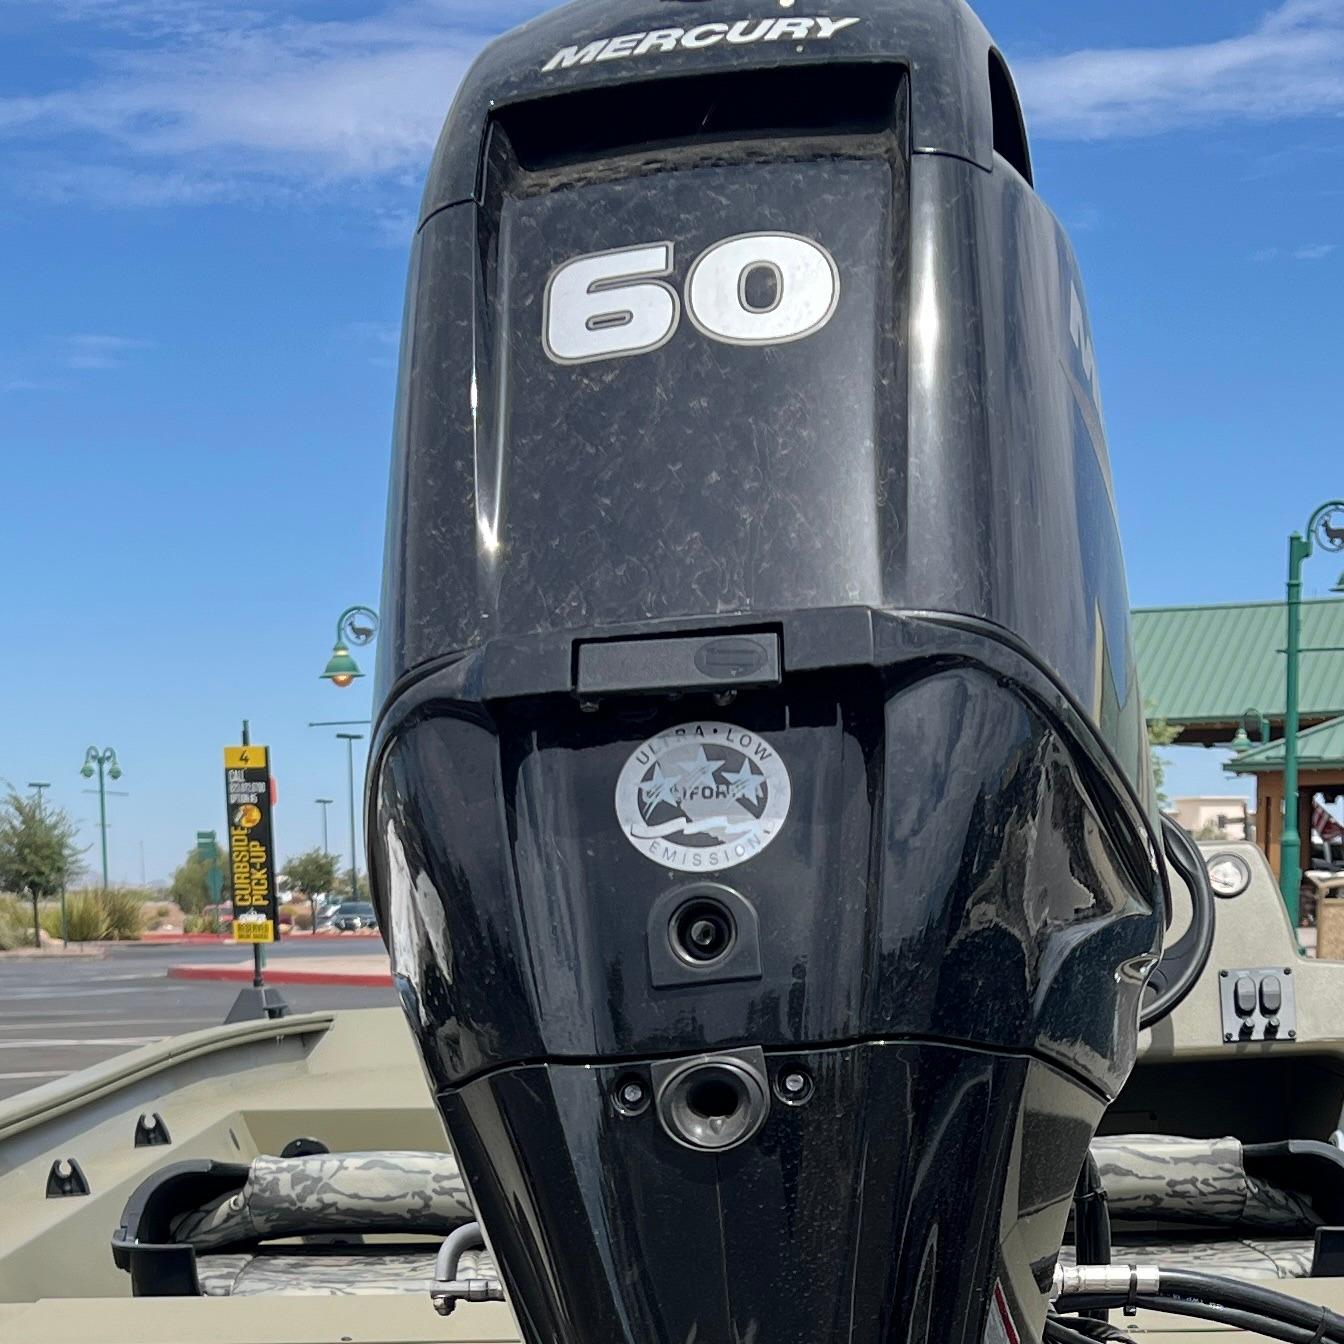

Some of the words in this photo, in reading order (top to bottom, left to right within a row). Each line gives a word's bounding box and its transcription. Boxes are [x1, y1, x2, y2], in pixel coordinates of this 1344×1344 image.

[542, 17, 860, 72] MERCURY
[542, 230, 841, 366] 60
[239, 750, 250, 765] 4
[726, 728, 772, 761] LOW
[231, 825, 251, 906] CURBSIDE
[249, 840, 269, 907] PICK-UP
